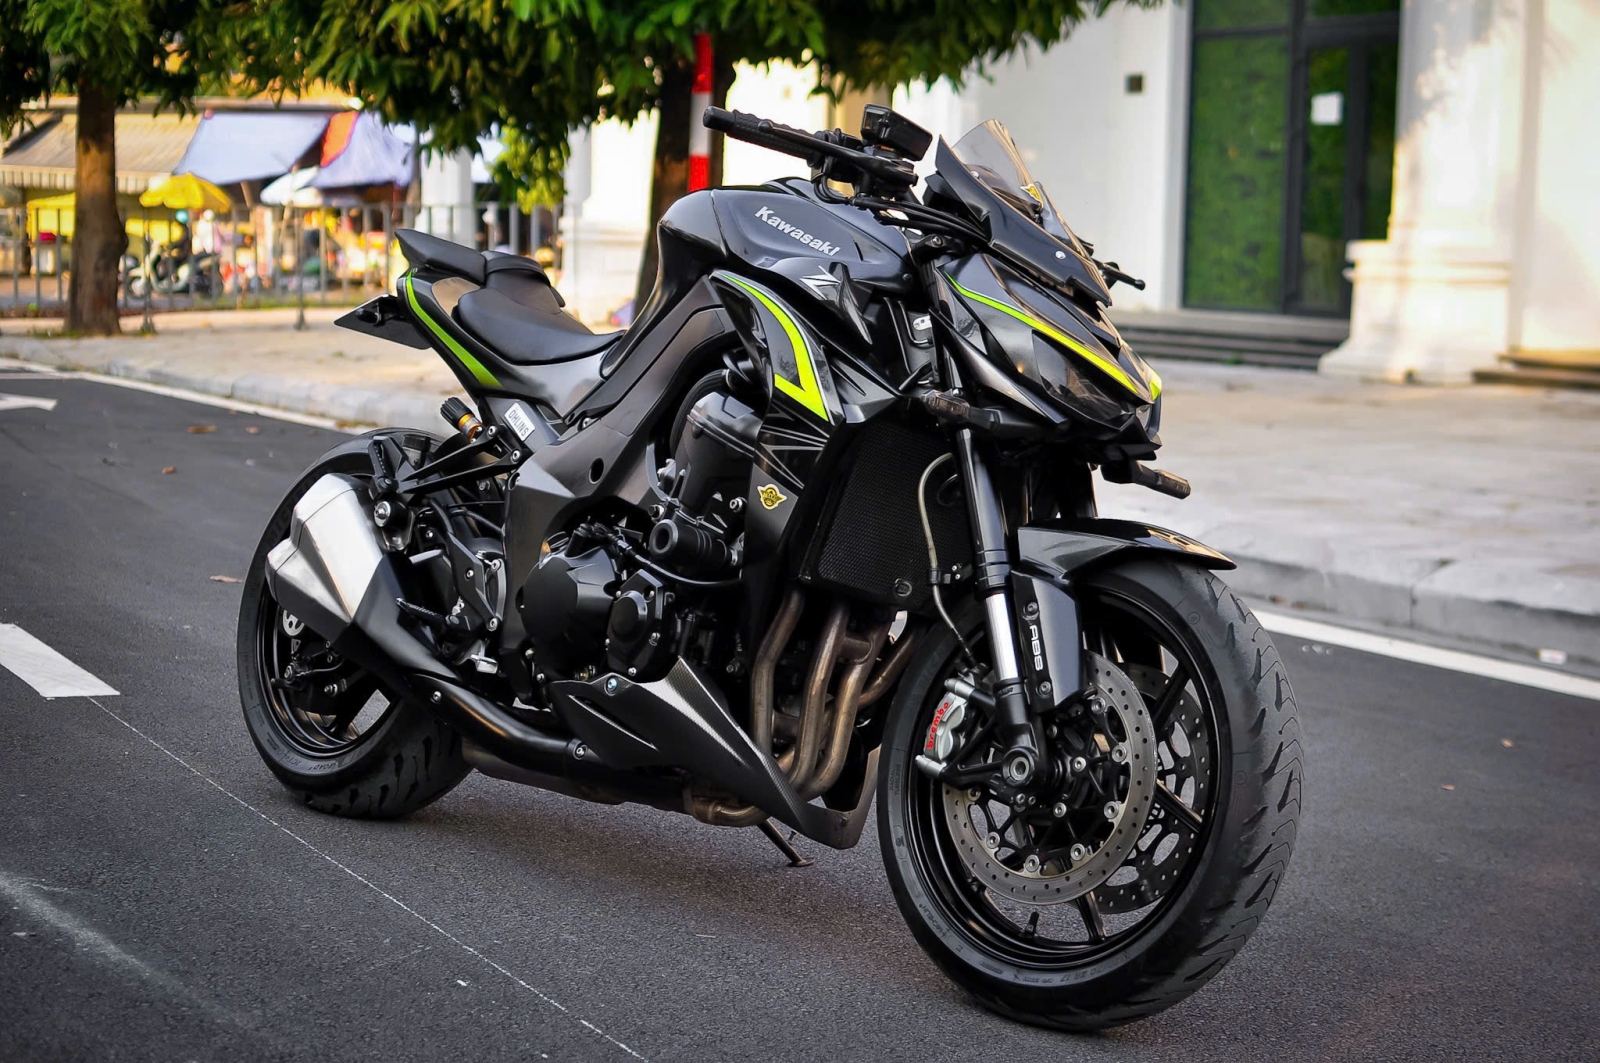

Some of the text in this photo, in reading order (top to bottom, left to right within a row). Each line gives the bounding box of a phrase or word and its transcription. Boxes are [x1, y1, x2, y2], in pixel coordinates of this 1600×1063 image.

[755, 206, 841, 256] Kawasaki
[1029, 624, 1043, 671] ABS
[925, 702, 949, 749] brembo
